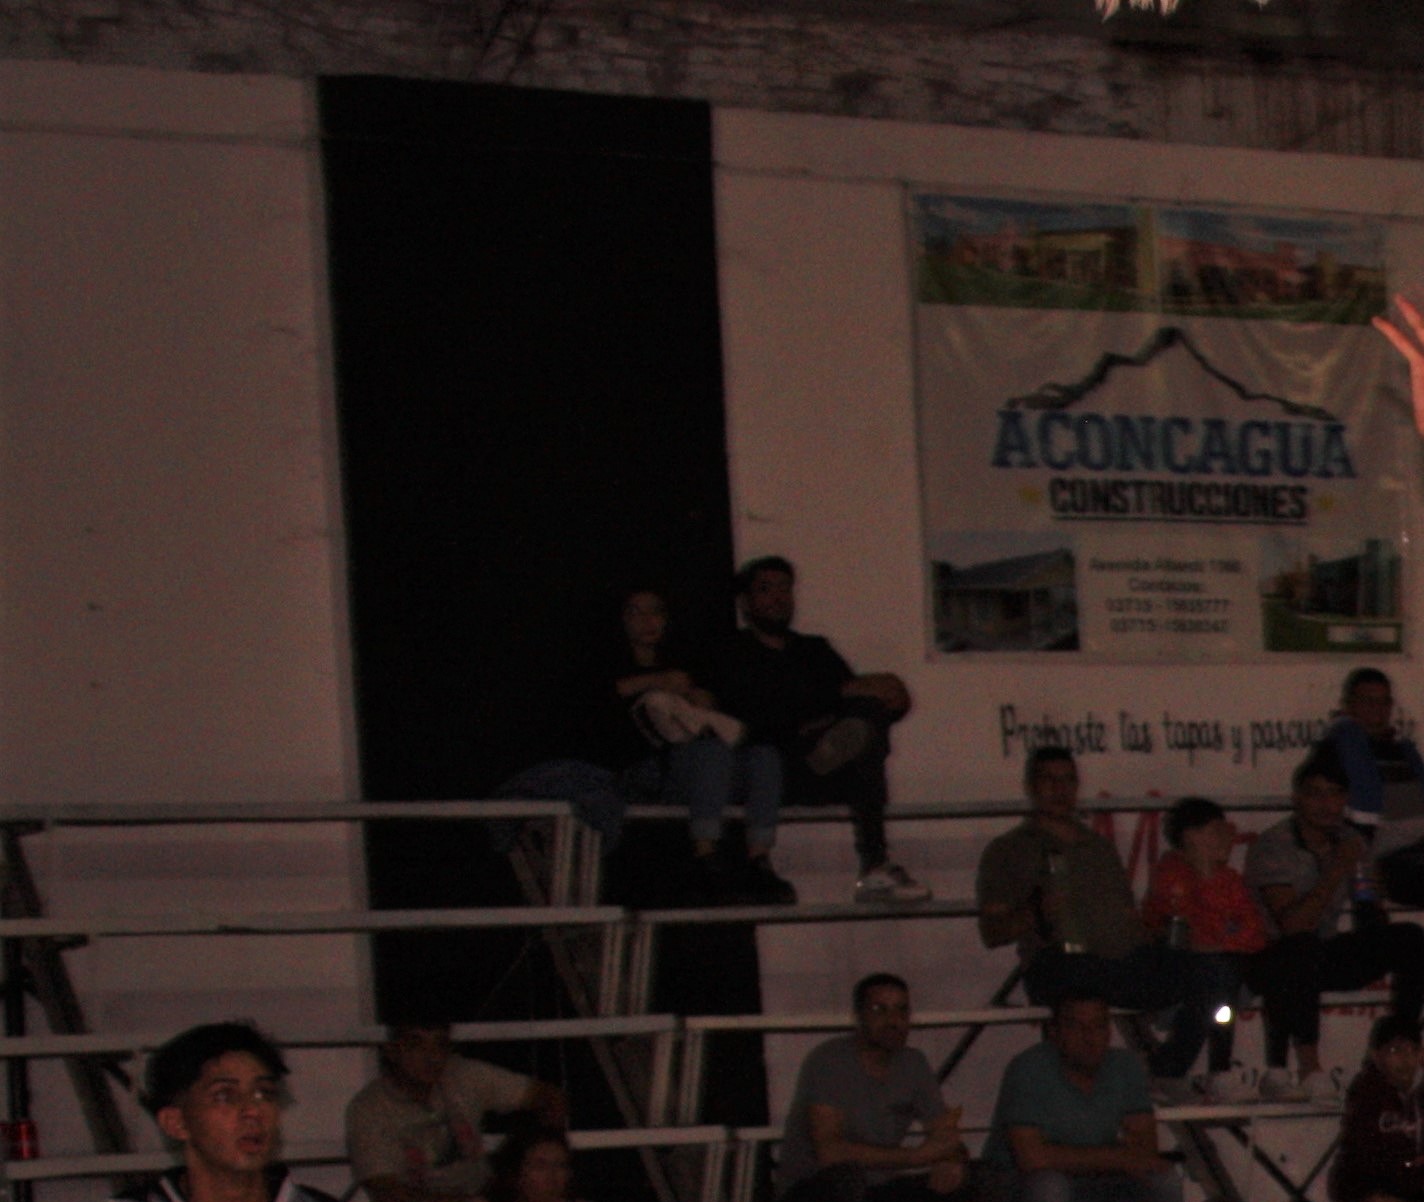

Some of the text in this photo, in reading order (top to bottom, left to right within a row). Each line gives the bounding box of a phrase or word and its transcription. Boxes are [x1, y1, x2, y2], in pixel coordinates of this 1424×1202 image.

[992, 410, 1357, 477] ACONCAGUA
[1049, 478, 1308, 520] CONSTRUCCIONES
[1118, 710, 1153, 754] las
[1162, 711, 1224, 766] tapas
